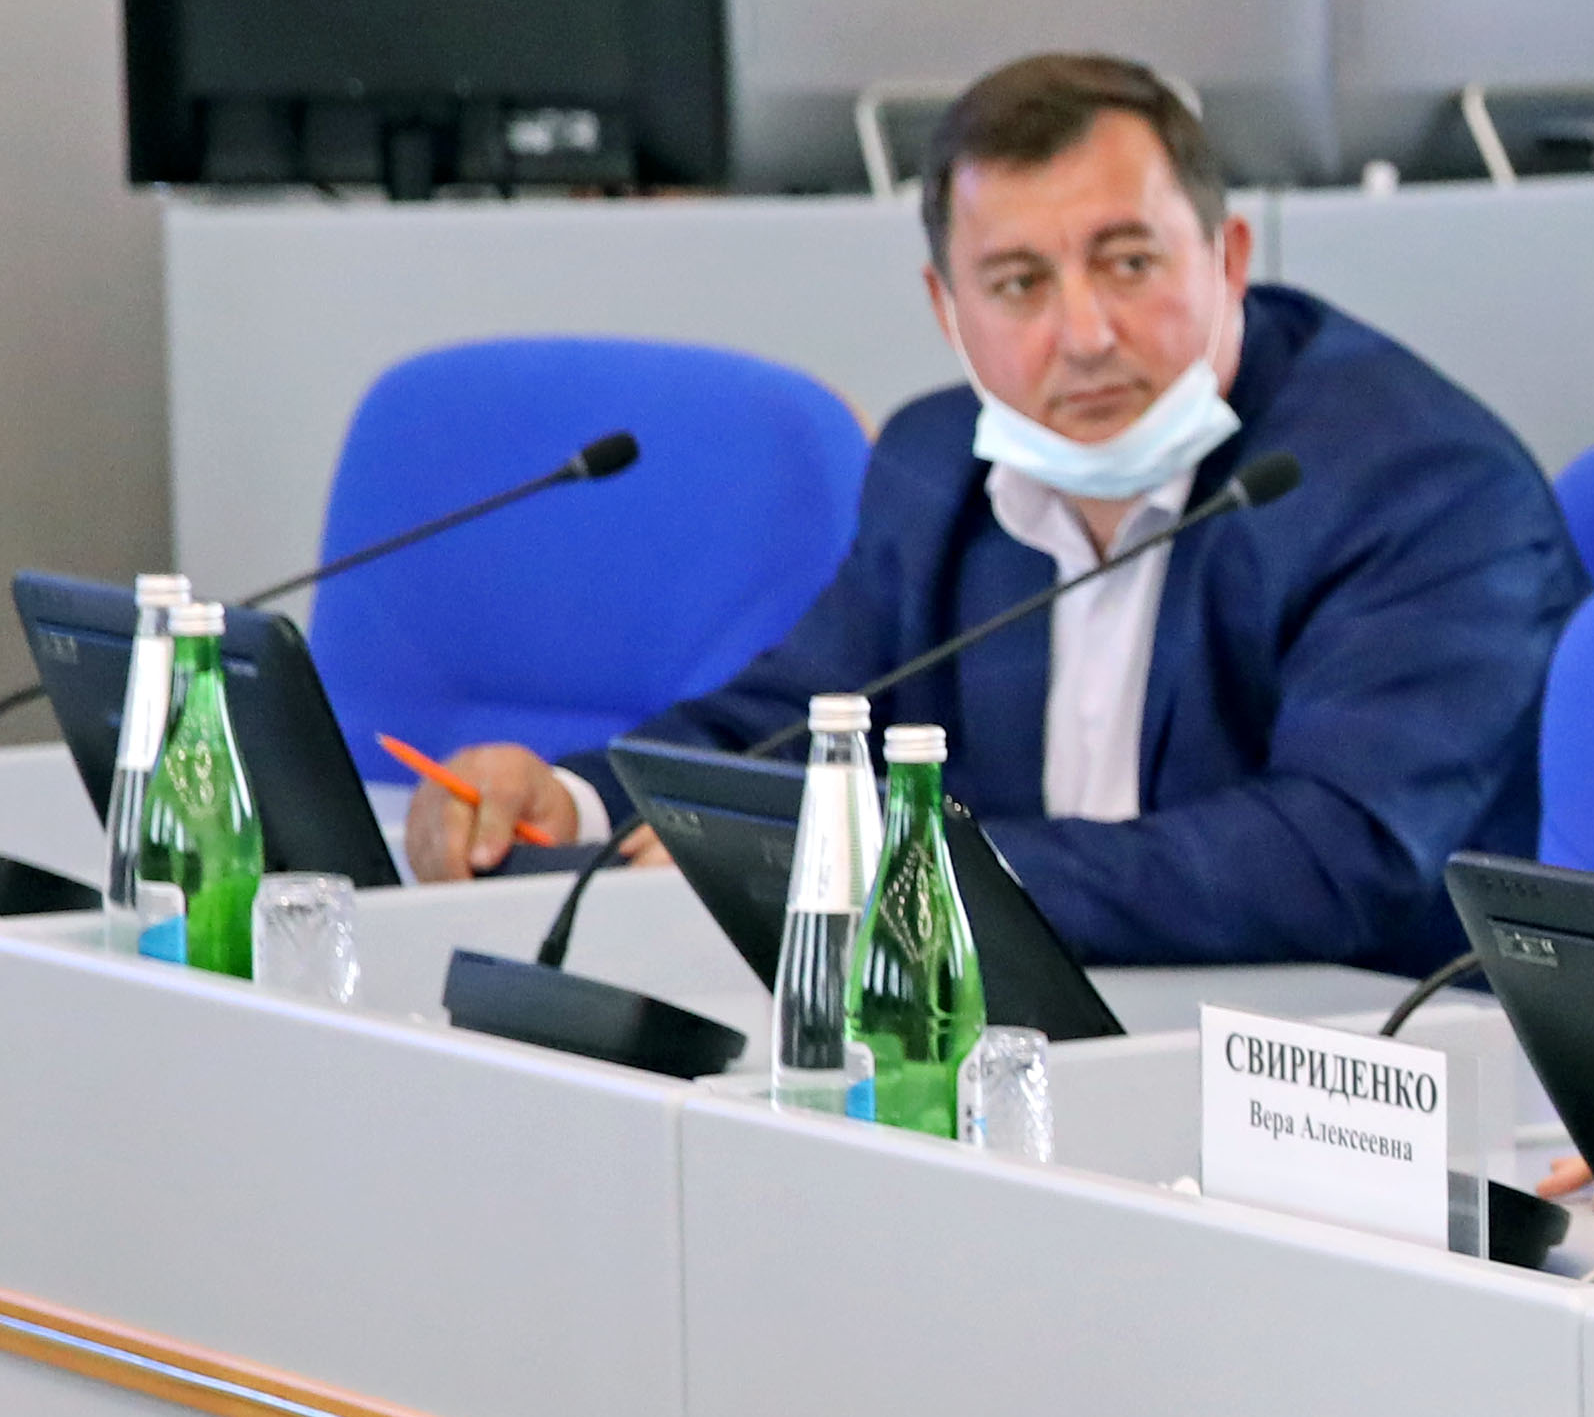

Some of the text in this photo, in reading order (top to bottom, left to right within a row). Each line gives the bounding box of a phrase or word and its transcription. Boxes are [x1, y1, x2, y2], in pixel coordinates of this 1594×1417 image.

[1226, 1032, 1438, 1114] СВИРИДЕНКО
[1250, 1100, 1413, 1162] Вера Алексеевна
